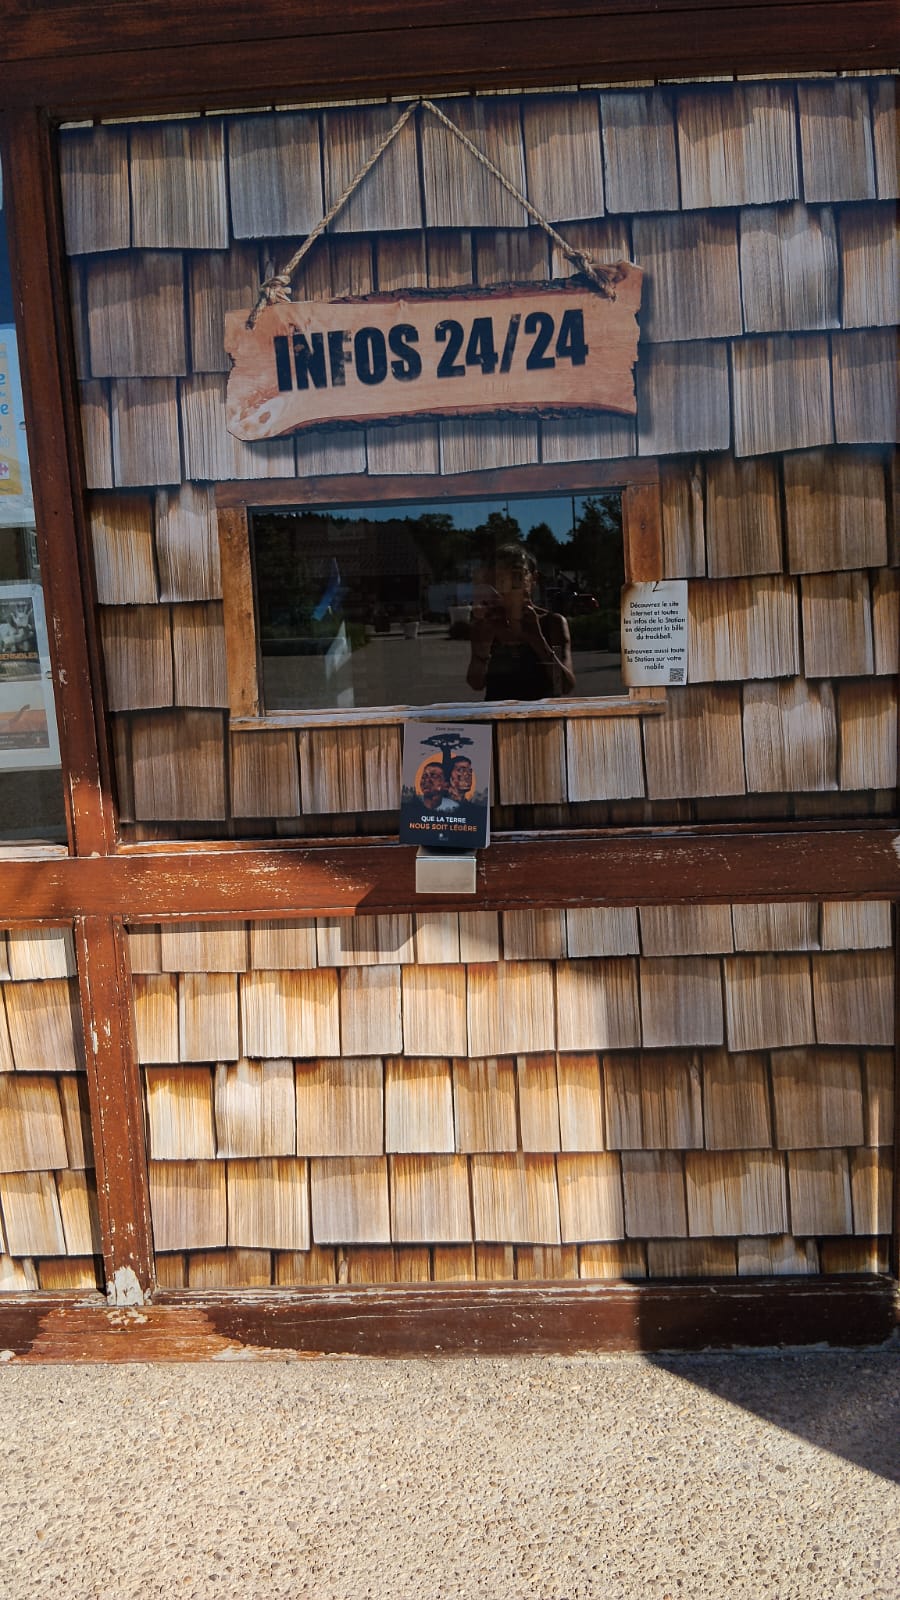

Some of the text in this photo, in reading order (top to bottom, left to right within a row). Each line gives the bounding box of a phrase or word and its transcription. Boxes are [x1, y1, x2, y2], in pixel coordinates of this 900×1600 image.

[273, 309, 589, 393] INFOS 24/24
[421, 815, 435, 823] QUE
[446, 816, 467, 824] TERRE
[409, 822, 430, 830] NOUS
[431, 823, 448, 831] SOIT
